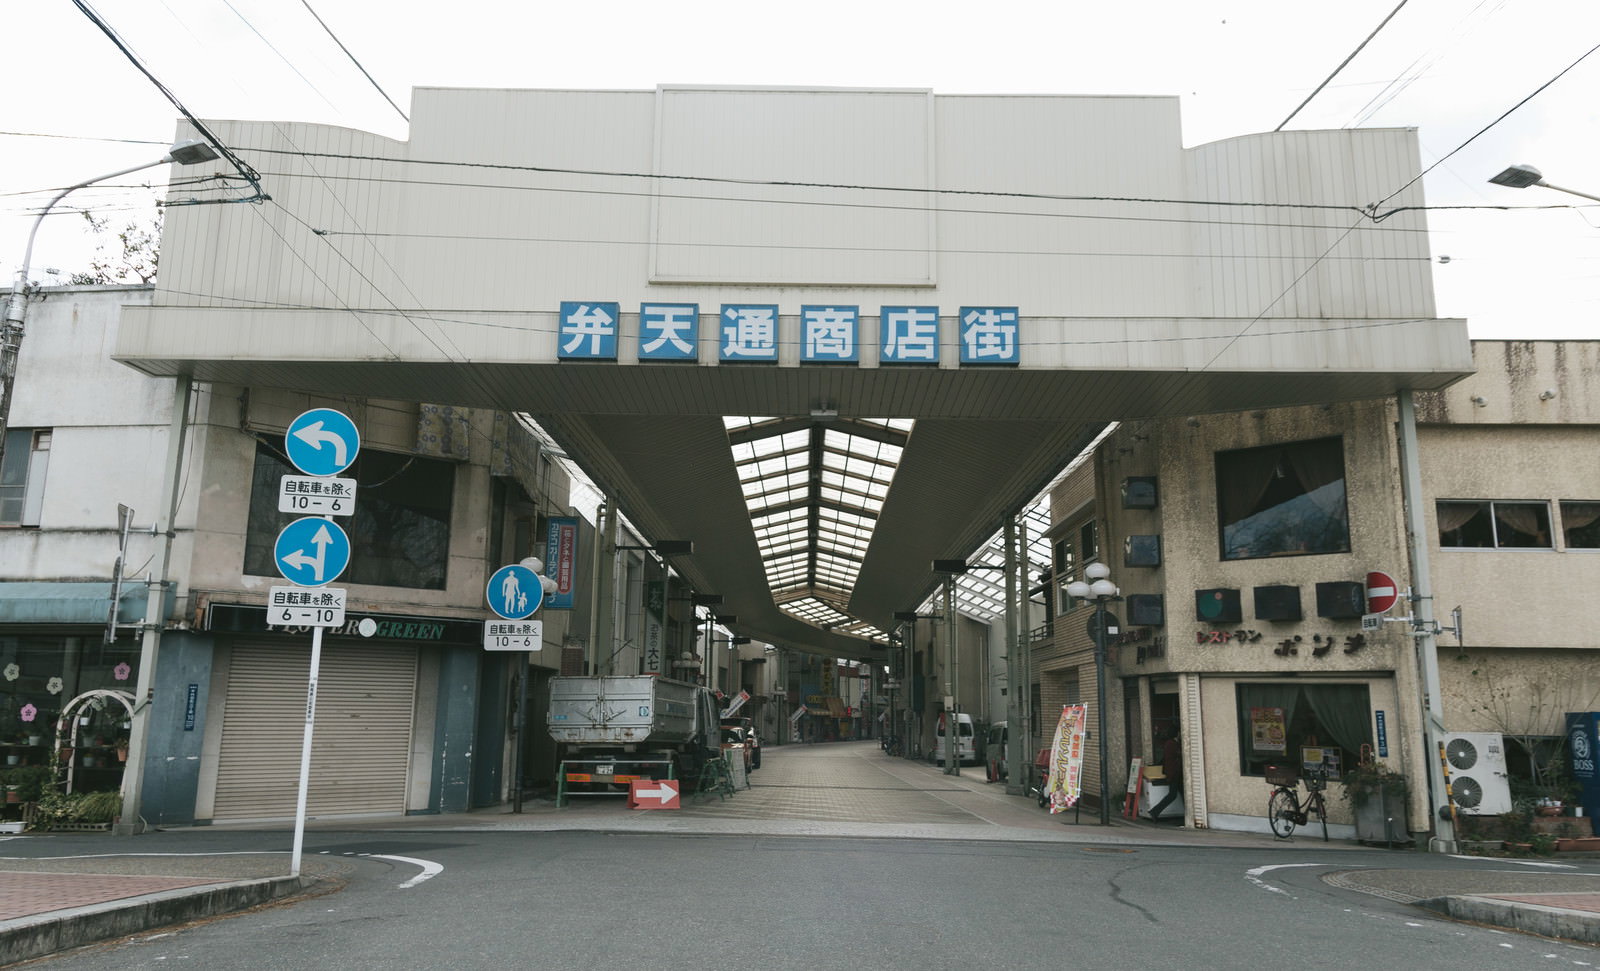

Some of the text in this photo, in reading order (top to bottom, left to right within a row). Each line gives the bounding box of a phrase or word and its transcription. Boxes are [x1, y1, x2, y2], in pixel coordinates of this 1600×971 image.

[562, 305, 1016, 359] 弁天通商店街
[285, 480, 352, 496] 自転車を除く
[273, 592, 341, 607] 自転車を除く
[375, 620, 446, 640] GREEN
[489, 623, 538, 635] 自転車を除く
[1196, 629, 1263, 644] レストラン
[647, 624, 659, 671] お茶の大七
[1573, 759, 1594, 770] BOSS
